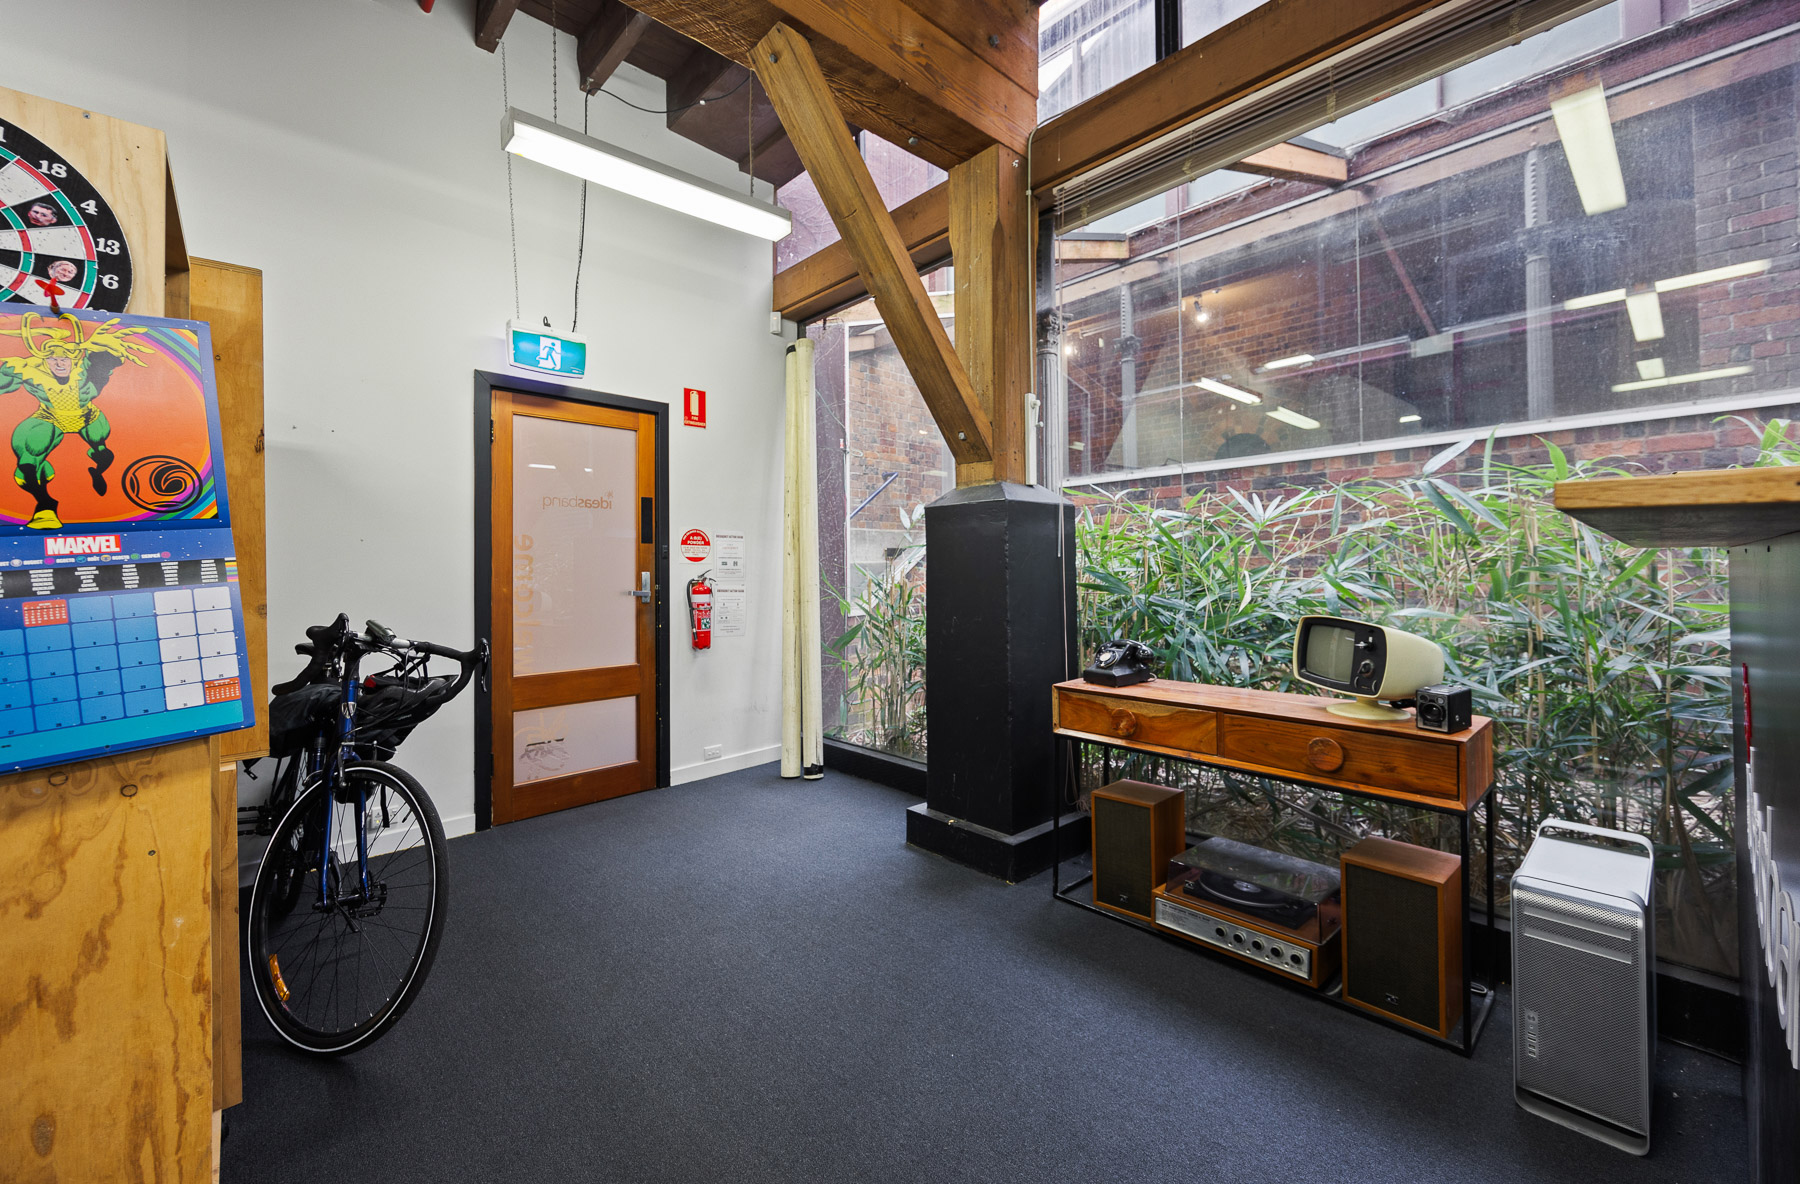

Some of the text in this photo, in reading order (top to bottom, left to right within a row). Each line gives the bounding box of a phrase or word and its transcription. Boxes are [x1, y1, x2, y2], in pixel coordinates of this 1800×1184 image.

[38, 160, 68, 179] 18
[80, 199, 98, 215] 4
[96, 237, 121, 256] 13
[102, 274, 119, 290] 6
[46, 535, 121, 556] MARVEL
